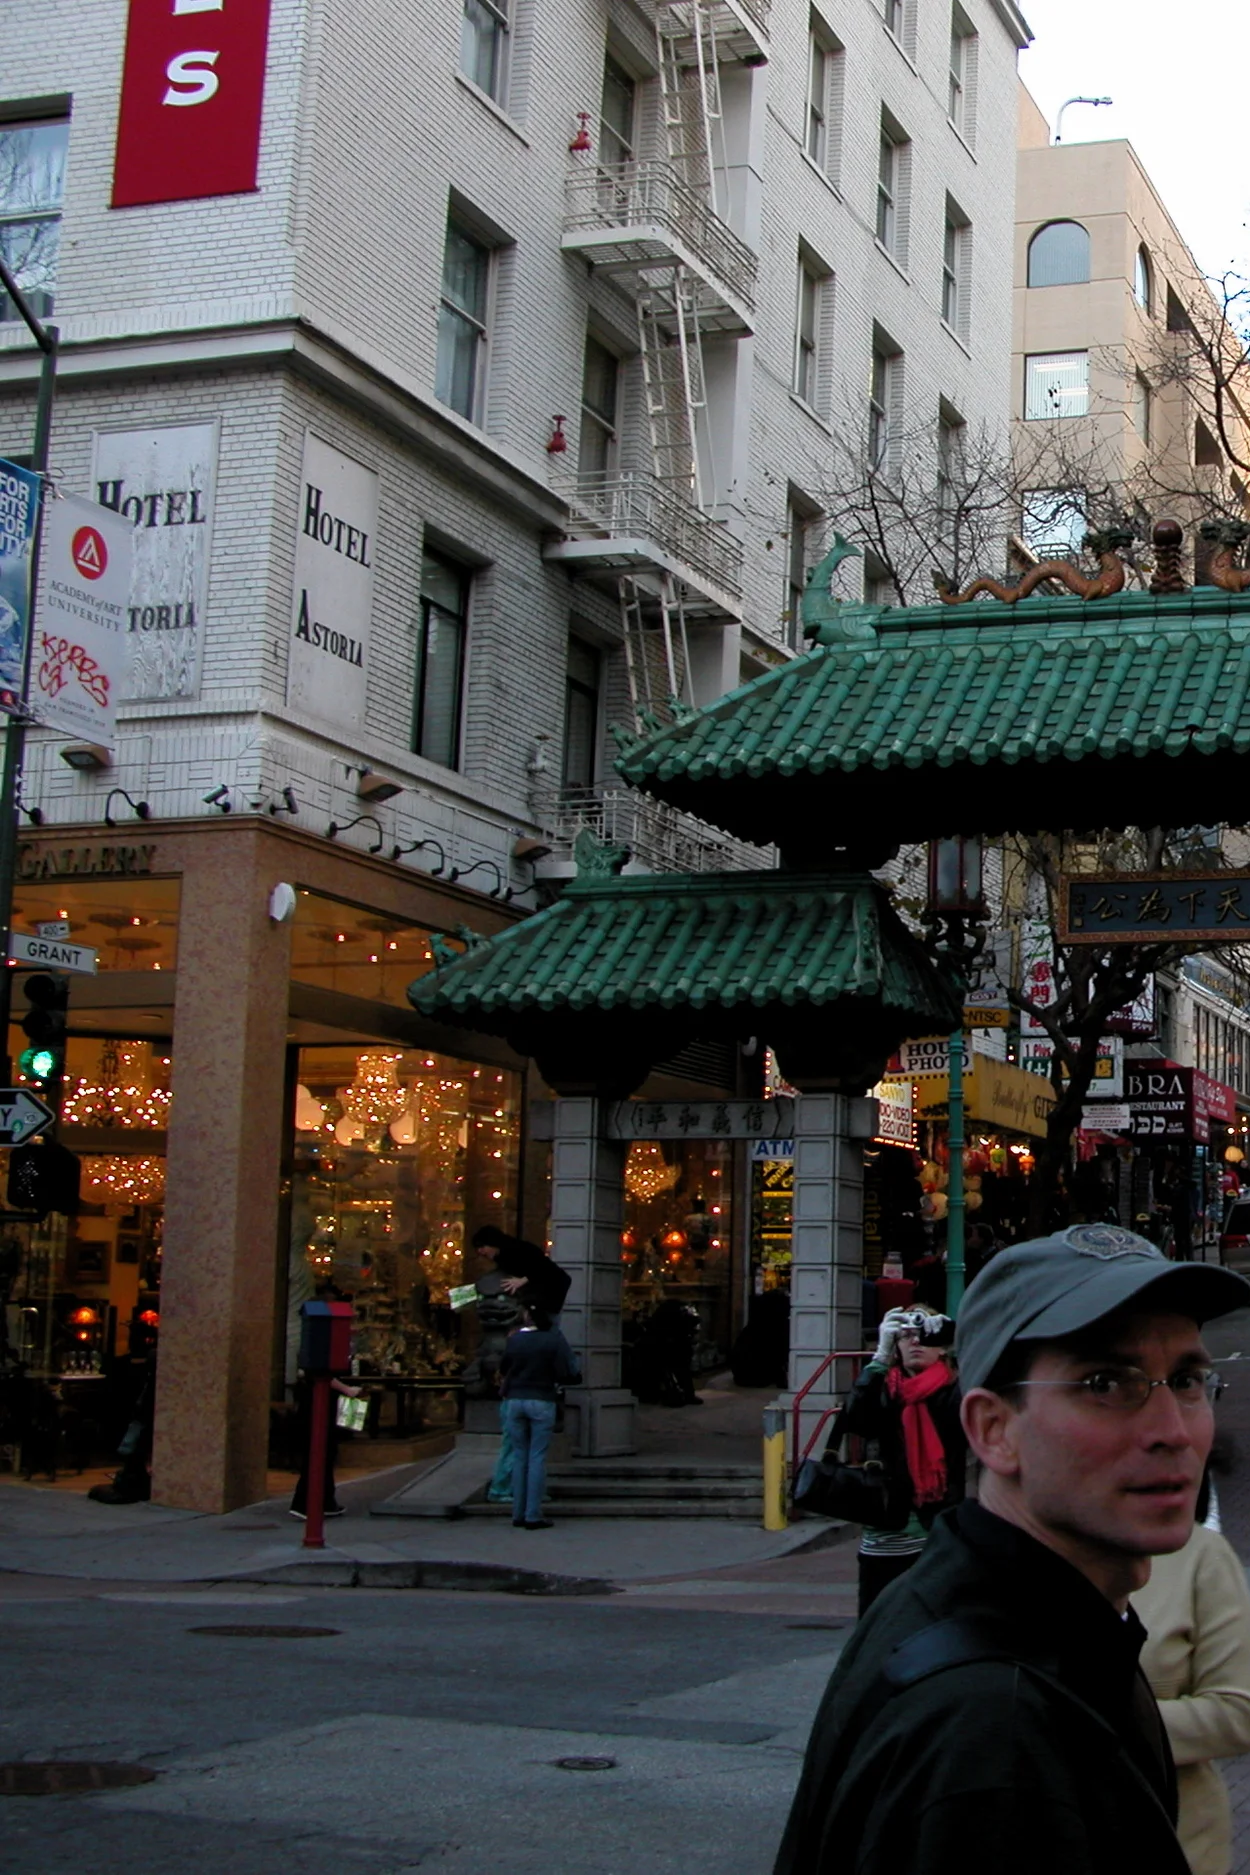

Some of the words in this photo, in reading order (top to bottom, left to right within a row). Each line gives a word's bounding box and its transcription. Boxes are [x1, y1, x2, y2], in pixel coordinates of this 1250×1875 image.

[0, 472, 29, 502] FOR
[0, 492, 28, 521] RTS
[97, 479, 206, 528] HOTEL
[302, 482, 371, 568] HOTEL
[0, 531, 26, 559] ITY
[50, 580, 95, 606] ACADEMY
[103, 602, 123, 616] ART
[48, 595, 121, 632] UNIVERSITY
[128, 602, 197, 633] TORIA
[295, 588, 363, 668] ASTORIA
[19, 844, 157, 878] GALLERY
[27, 942, 81, 966] GRANT
[907, 1040, 969, 1057] HOU
[907, 1054, 969, 1071] PHOO
[1128, 1074, 1185, 1094] BRA
[1130, 1101, 1185, 1111] ESTAURANT
[756, 1140, 795, 1155] ATM
